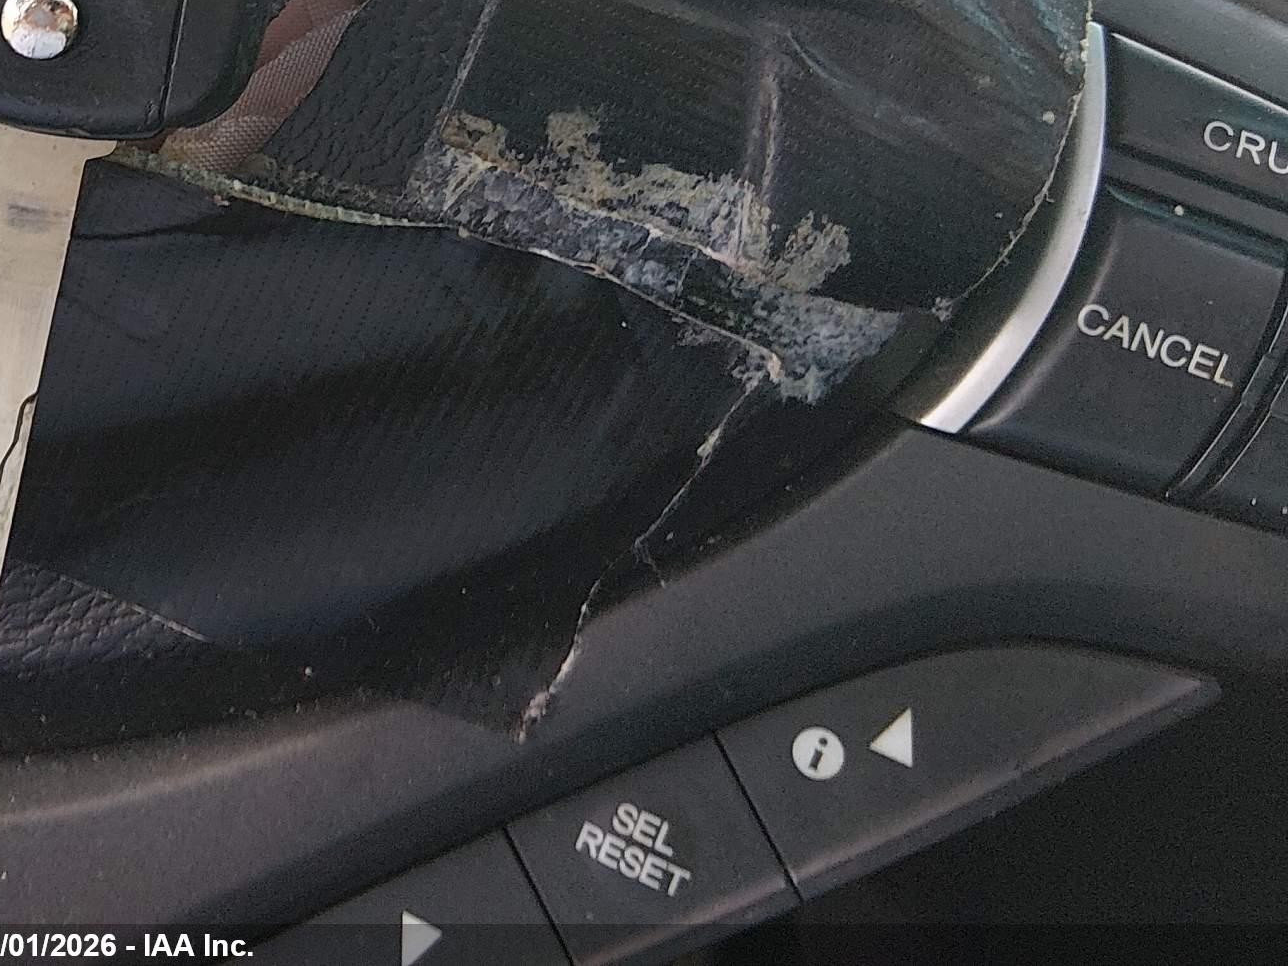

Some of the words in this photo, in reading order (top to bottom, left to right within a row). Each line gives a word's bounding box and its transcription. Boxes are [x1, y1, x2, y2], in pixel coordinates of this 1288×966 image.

[1202, 119, 1288, 175] CRU
[1076, 303, 1235, 388] CANCEL
[575, 820, 692, 897] RESET
[612, 802, 674, 858] SEL
